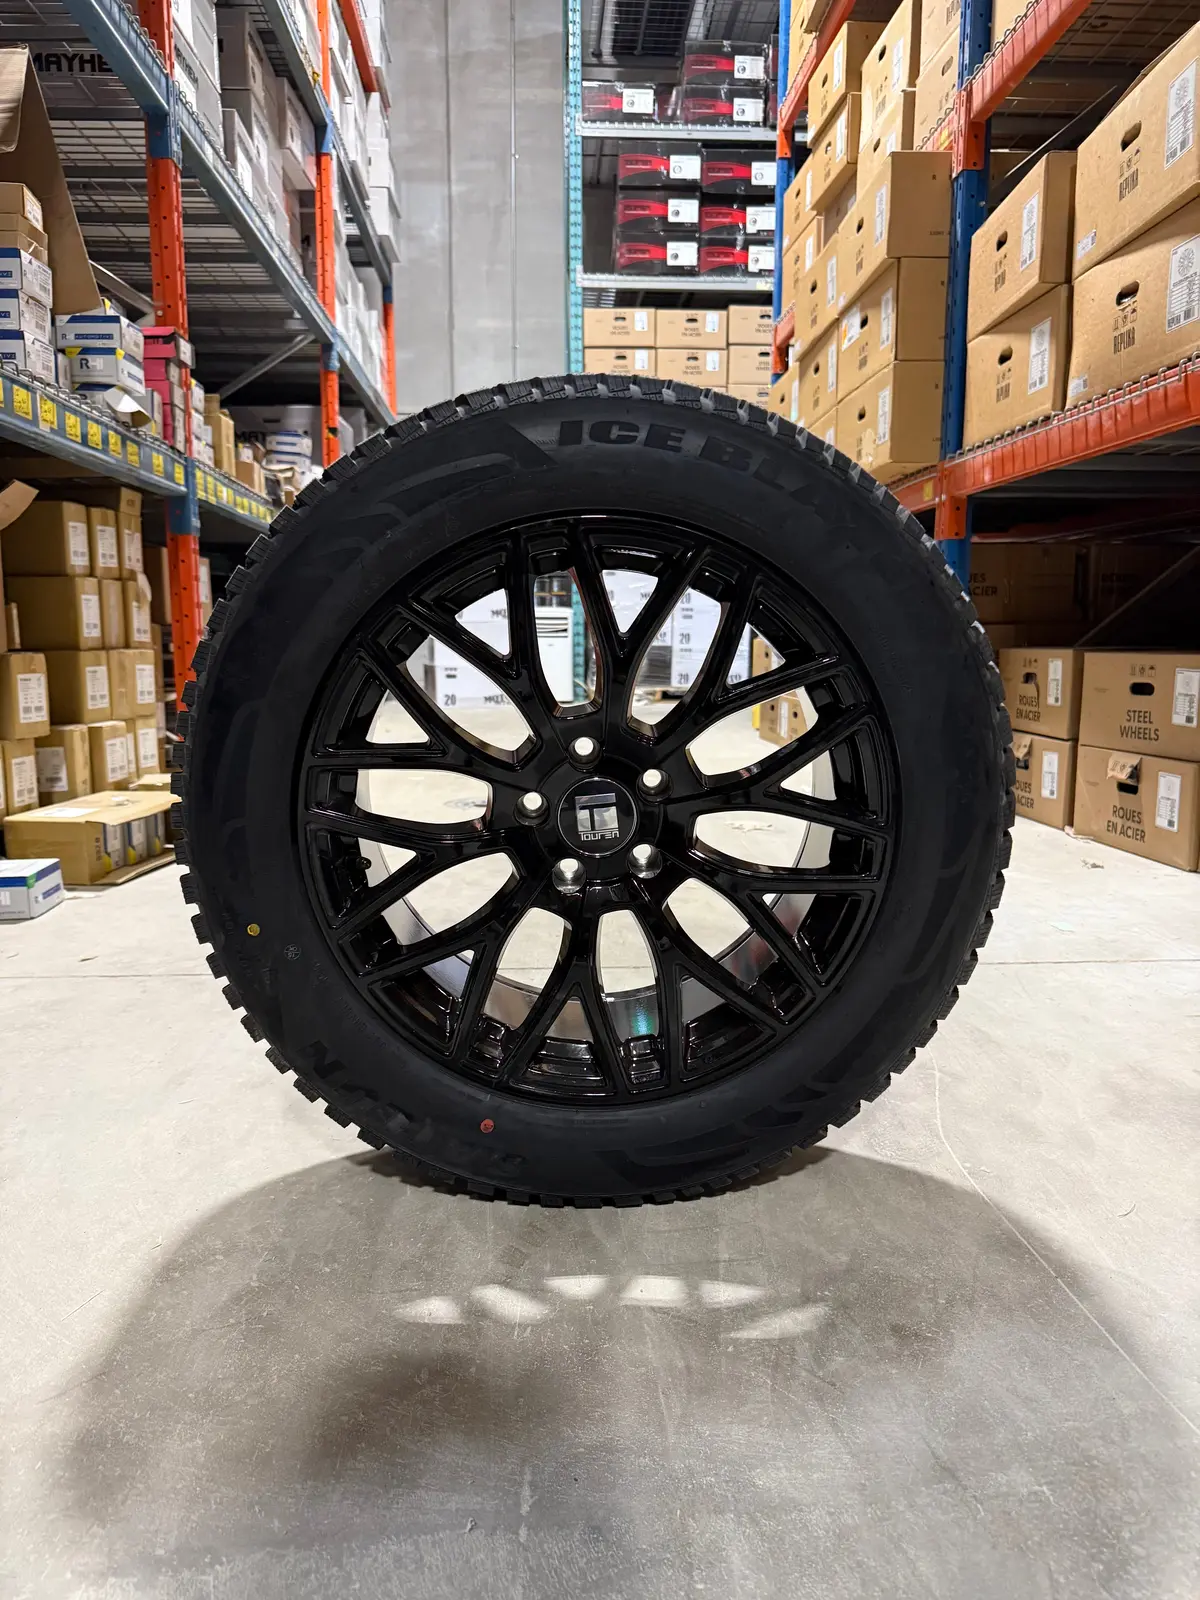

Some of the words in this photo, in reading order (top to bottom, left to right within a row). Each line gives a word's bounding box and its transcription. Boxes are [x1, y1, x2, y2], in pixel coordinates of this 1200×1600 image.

[558, 420, 686, 453] ICE
[968, 573, 986, 584] UES
[679, 633, 690, 645] 20
[444, 694, 457, 707] 20
[1018, 694, 1038, 708] ROUES
[1016, 707, 1024, 719] EN
[1023, 709, 1041, 723] ACIER
[1126, 709, 1153, 724] STEEL
[1119, 725, 1159, 742] WHEELS
[1015, 780, 1032, 794] OUES
[1112, 804, 1142, 825] ROUES
[1106, 820, 1118, 836] EN
[1119, 822, 1146, 844] ACIER
